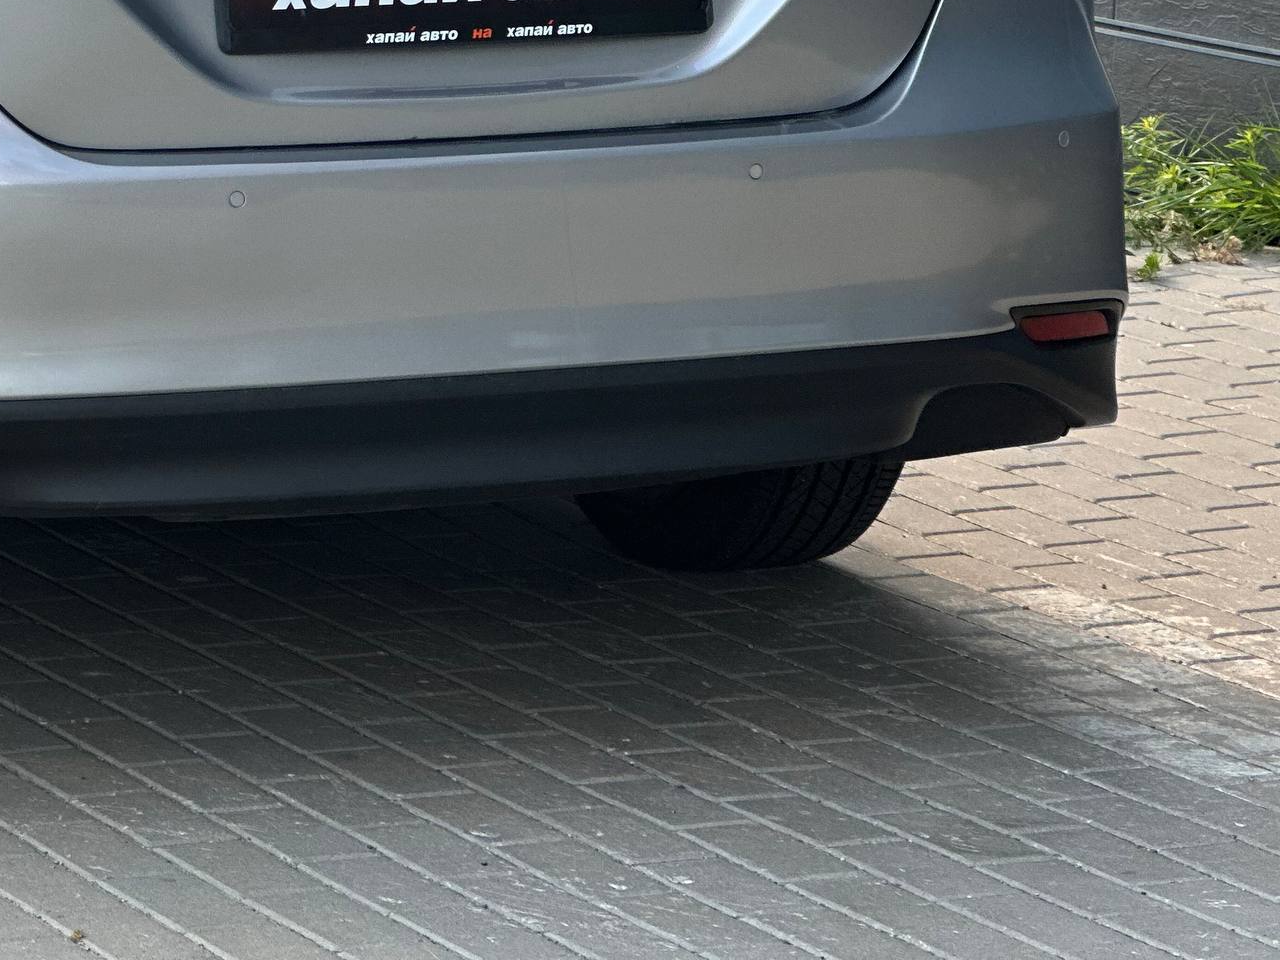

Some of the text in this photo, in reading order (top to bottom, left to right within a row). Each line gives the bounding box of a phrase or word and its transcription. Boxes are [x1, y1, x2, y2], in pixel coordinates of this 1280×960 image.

[420, 28, 459, 42] авто
[472, 26, 493, 39] на
[557, 22, 593, 35] авто
